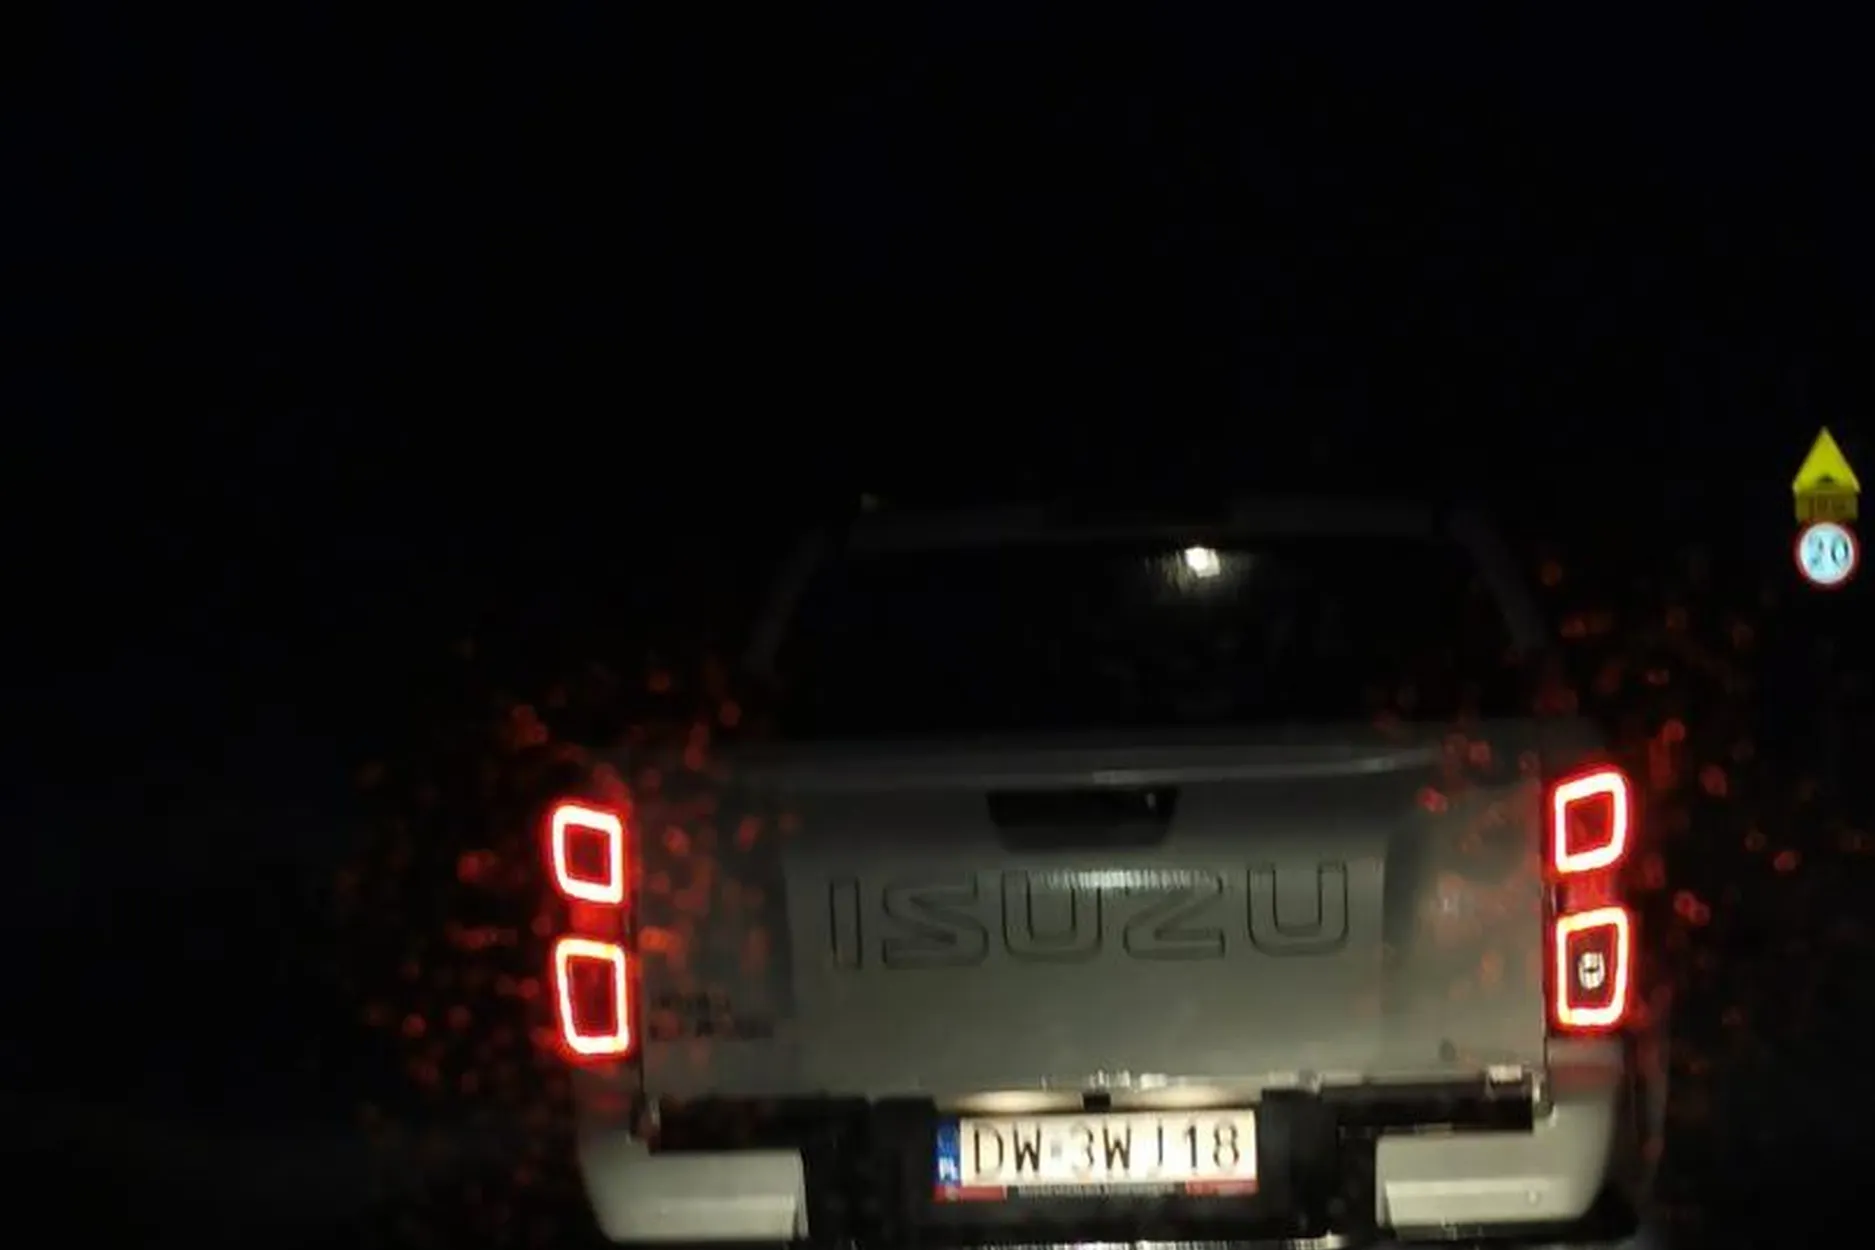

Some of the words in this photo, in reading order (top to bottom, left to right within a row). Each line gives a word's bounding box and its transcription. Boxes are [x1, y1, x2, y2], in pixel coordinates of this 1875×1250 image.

[1807, 534, 1849, 570] 20
[830, 861, 1349, 970] ISUZU
[973, 1121, 1042, 1179] DW
